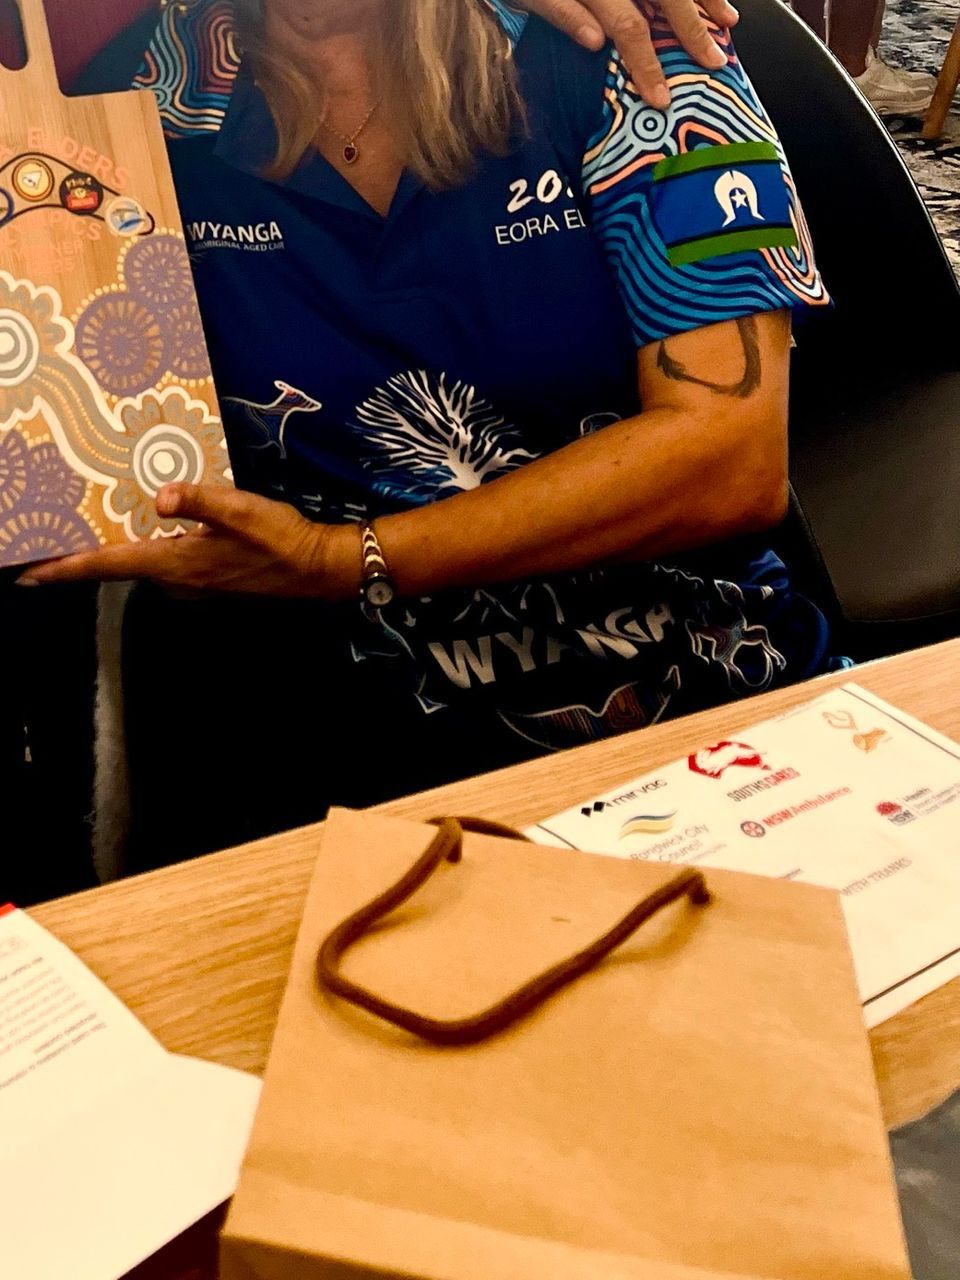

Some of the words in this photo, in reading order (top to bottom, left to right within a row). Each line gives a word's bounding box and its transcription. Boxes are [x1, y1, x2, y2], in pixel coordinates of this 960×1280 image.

[27, 126, 130, 190] ELDERS
[506, 169, 575, 214] 20
[186, 221, 283, 243] WYANGA
[494, 213, 560, 245] EORA
[243, 242, 268, 252] AGED
[612, 779, 668, 807] mirvac
[867, 856, 913, 882] THANKS
